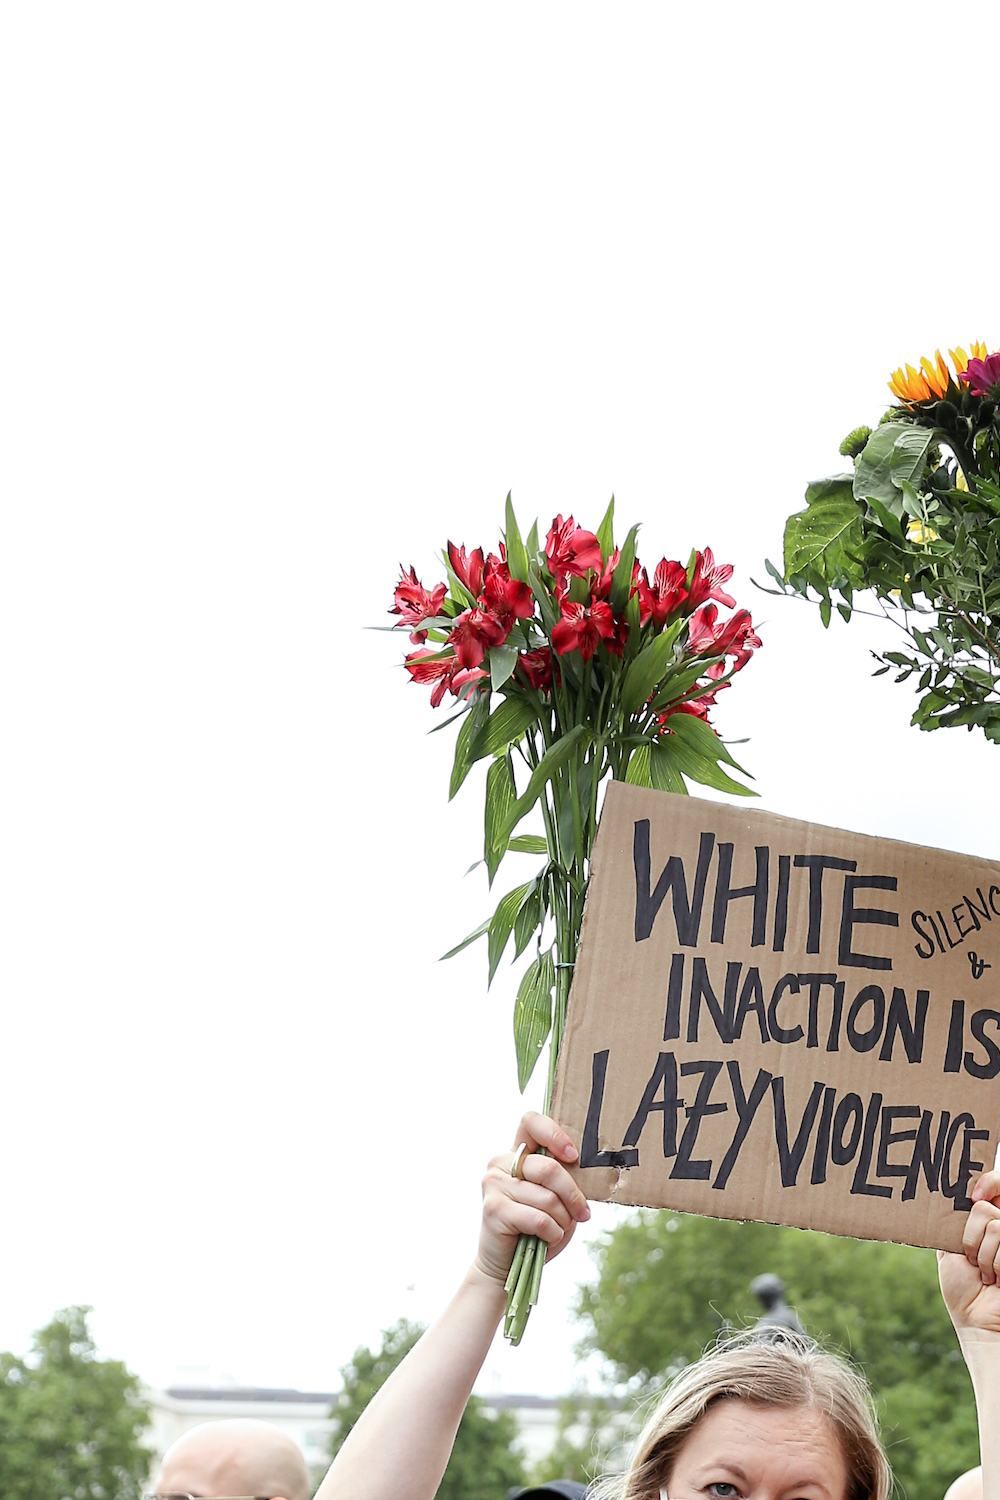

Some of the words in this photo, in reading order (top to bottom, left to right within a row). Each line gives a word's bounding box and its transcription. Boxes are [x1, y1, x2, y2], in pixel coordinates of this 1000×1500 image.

[633, 818, 899, 971] WHITE
[663, 953, 930, 1063] INACTION
[967, 951, 992, 980] &
[579, 1048, 773, 1190] LAZY
[771, 1076, 990, 1211] VIOLENCE
